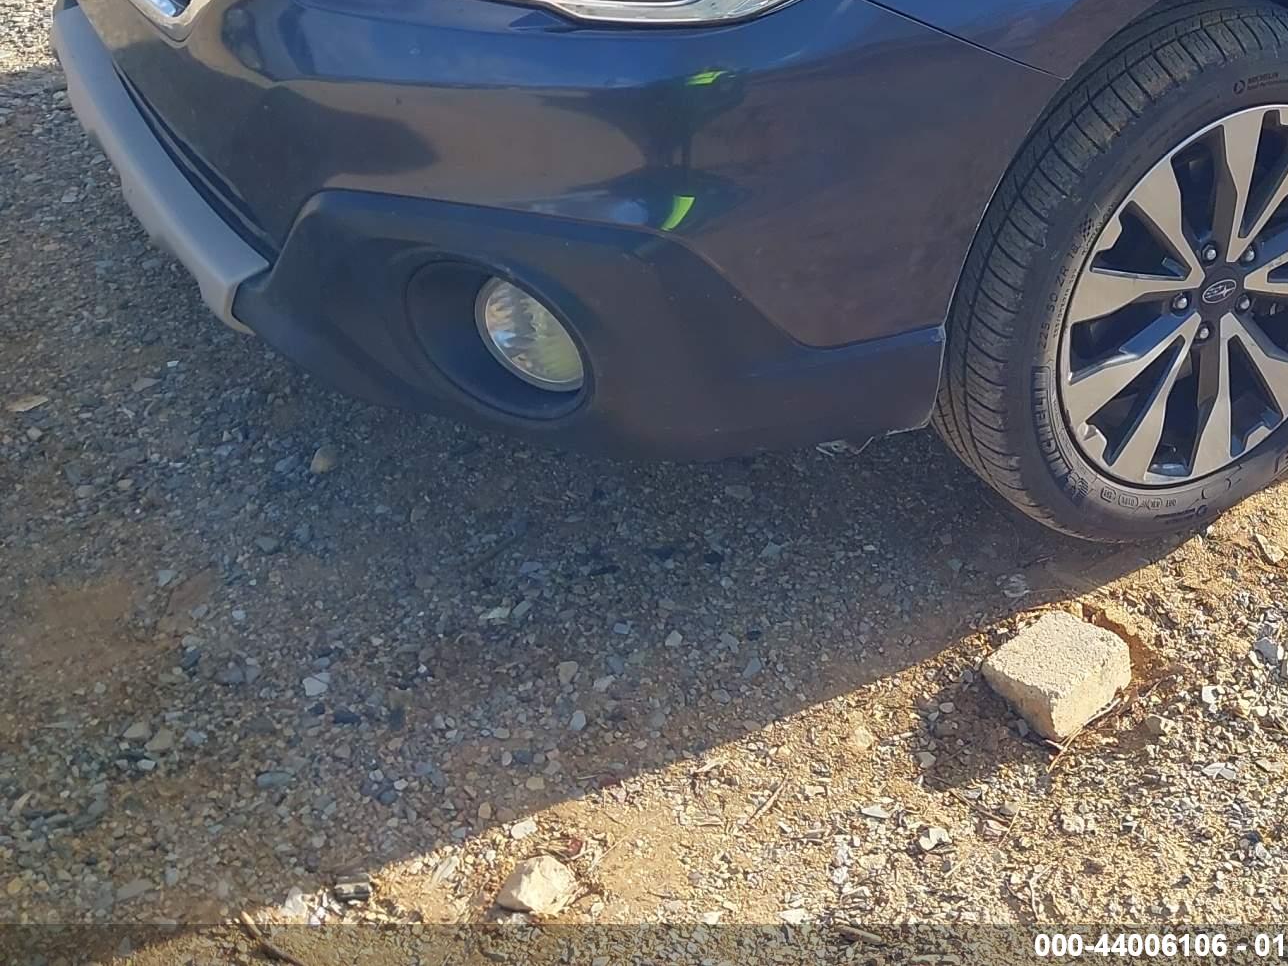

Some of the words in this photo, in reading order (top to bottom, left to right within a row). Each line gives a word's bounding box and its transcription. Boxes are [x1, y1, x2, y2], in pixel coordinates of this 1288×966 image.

[1039, 322, 1050, 349] 225
[1055, 265, 1070, 287] ZR
[1033, 372, 1070, 478] MICHELIN
